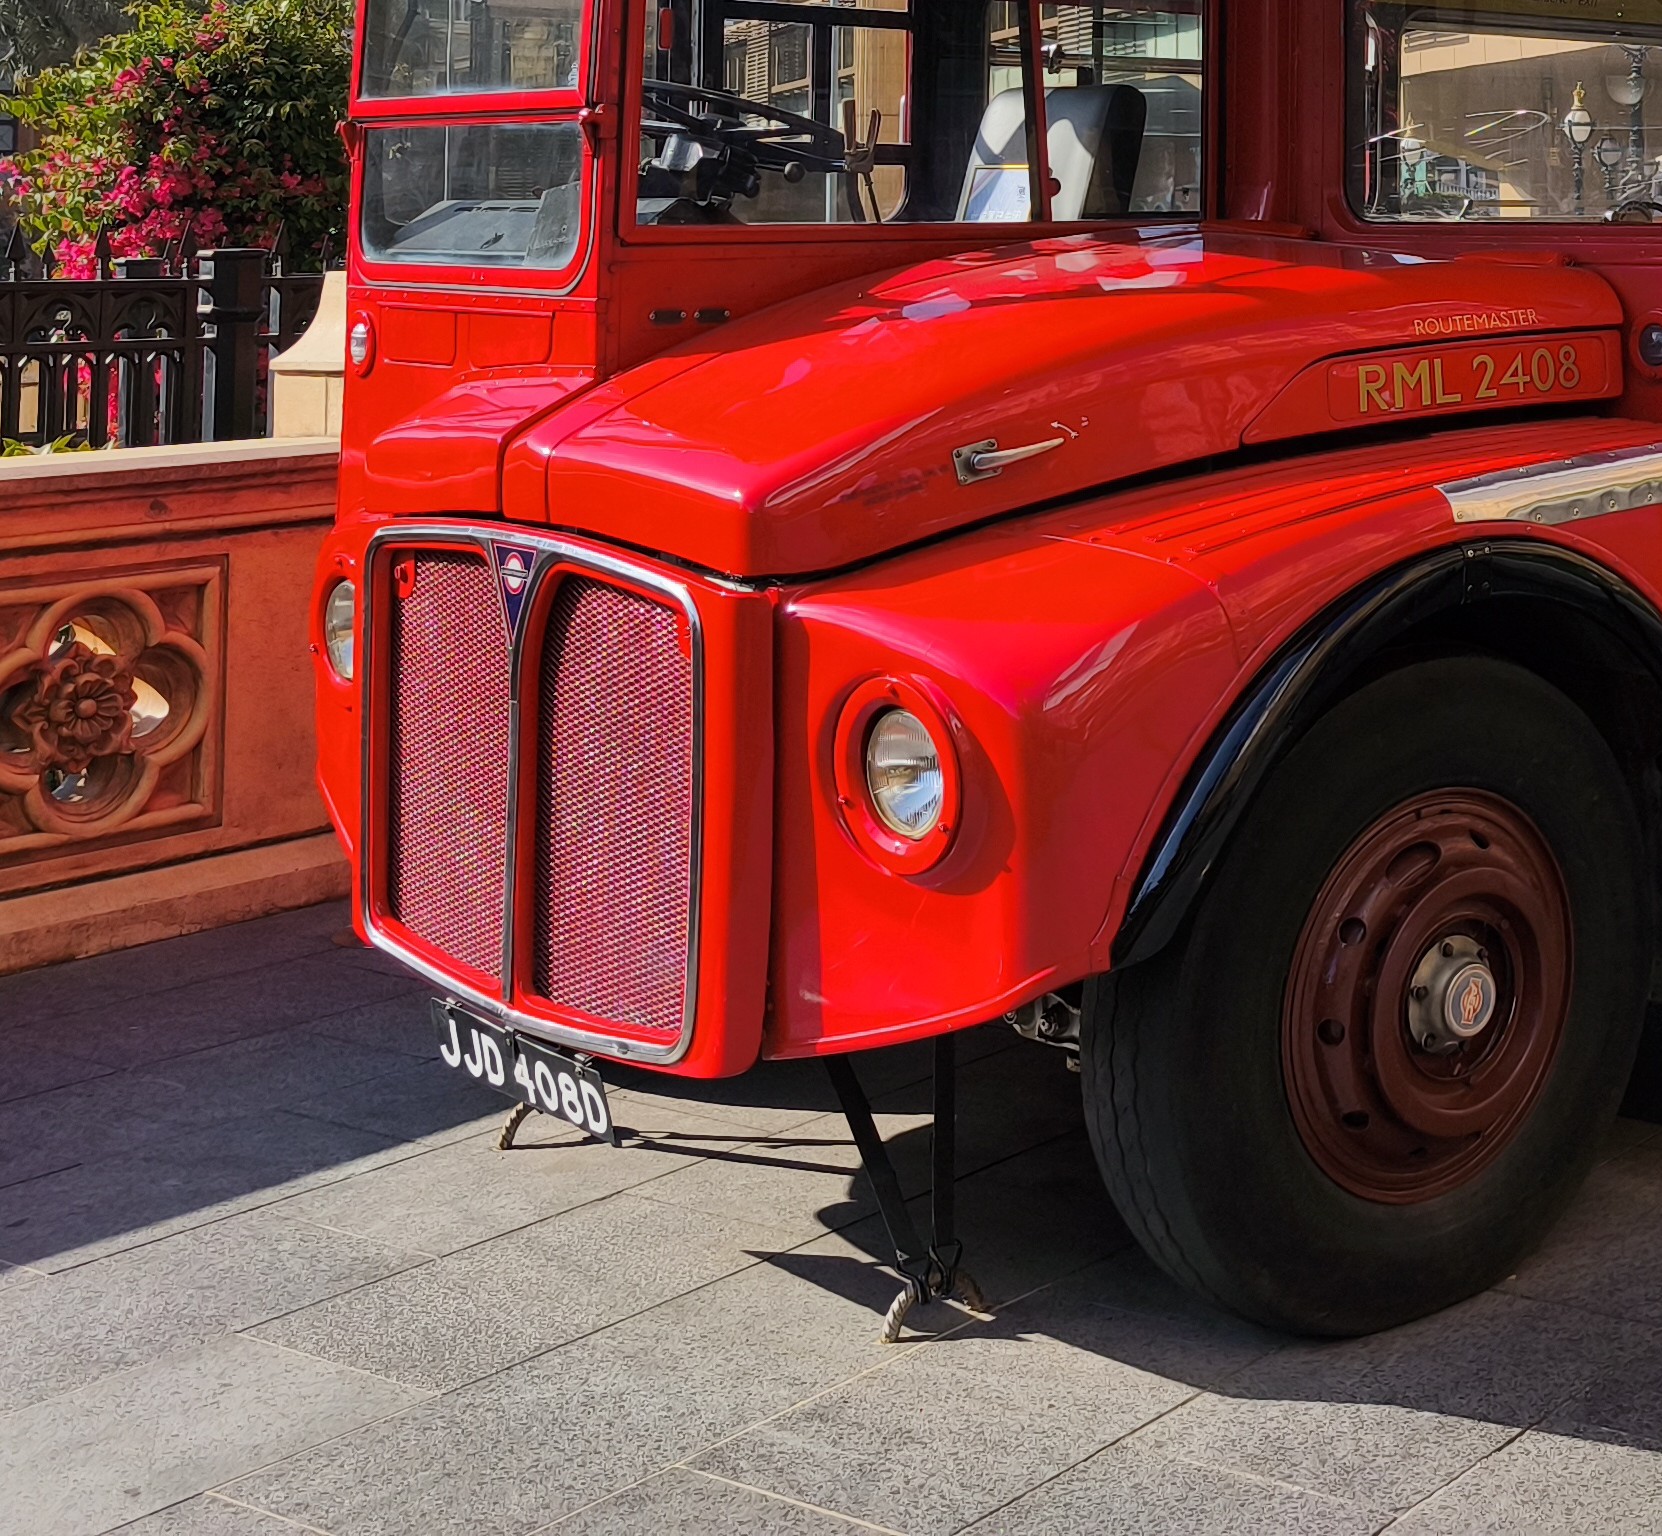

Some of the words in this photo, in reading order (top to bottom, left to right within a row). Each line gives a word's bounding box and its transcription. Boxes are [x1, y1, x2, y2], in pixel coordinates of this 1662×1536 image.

[1413, 308, 1538, 336] ROUTEMASTER
[1357, 358, 1462, 413] RML
[1473, 345, 1581, 399] 2408
[440, 1019, 505, 1087] JJD
[514, 1054, 608, 1134] 408D
